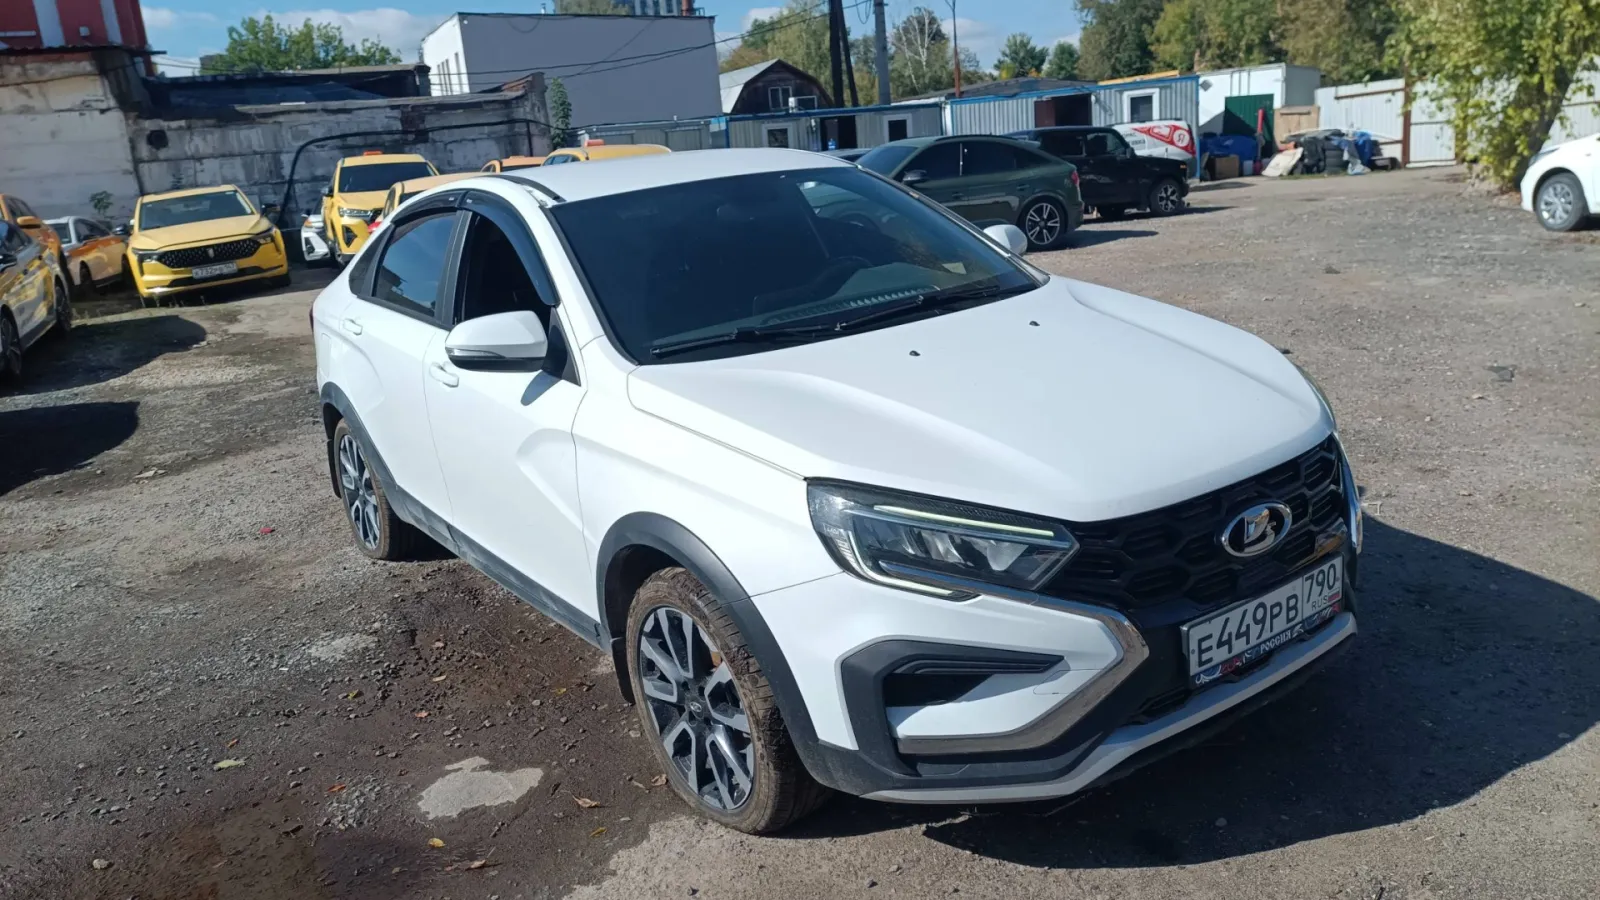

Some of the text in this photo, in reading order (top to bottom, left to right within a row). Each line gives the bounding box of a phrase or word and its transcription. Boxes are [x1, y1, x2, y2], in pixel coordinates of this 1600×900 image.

[1198, 563, 1337, 668] Е449РВ 790
[1311, 596, 1328, 610] RUS
[1260, 629, 1292, 654] РОССИЯ
